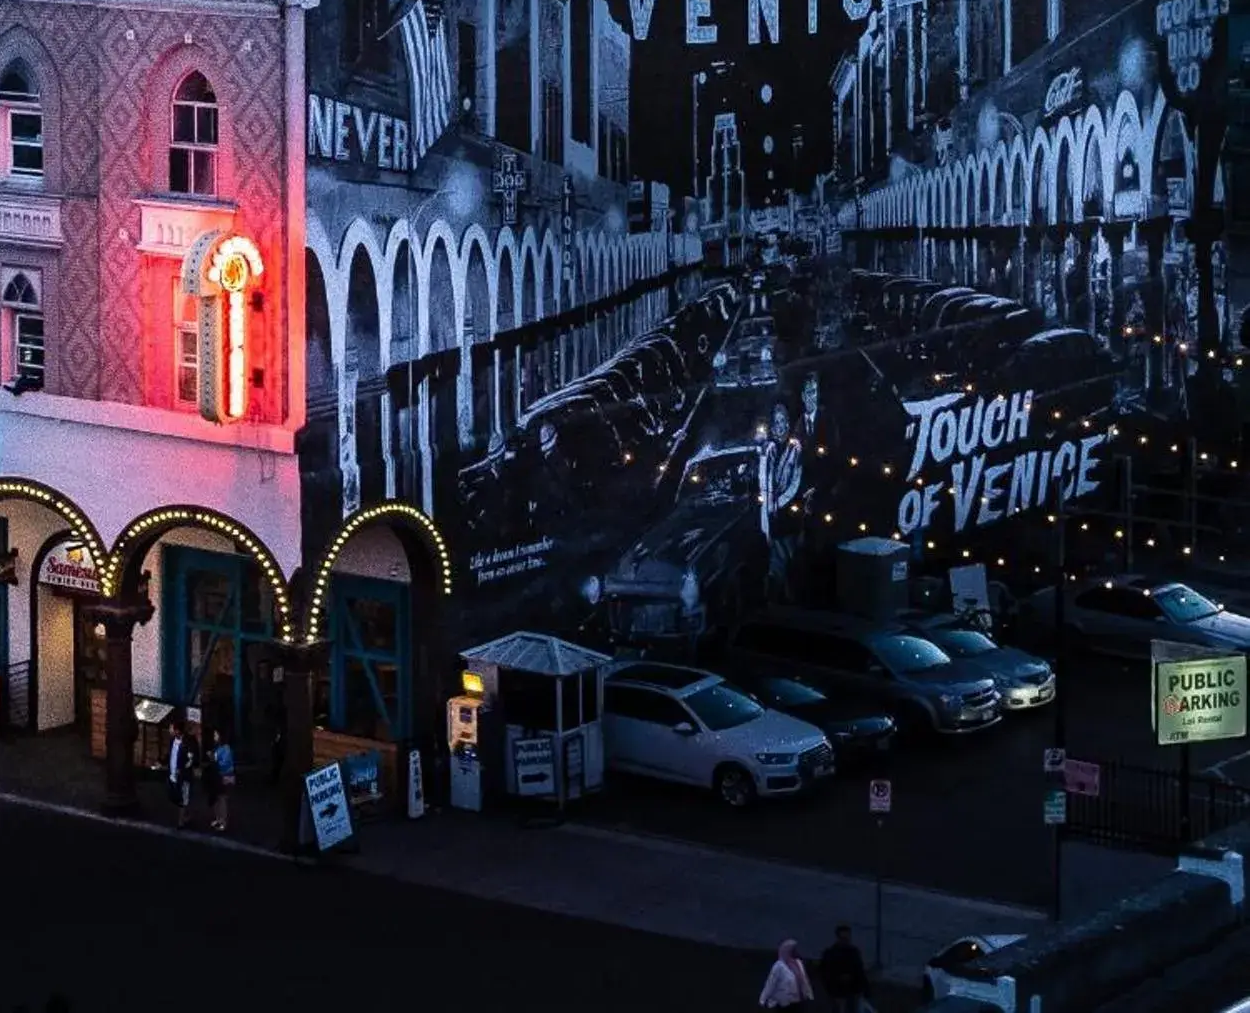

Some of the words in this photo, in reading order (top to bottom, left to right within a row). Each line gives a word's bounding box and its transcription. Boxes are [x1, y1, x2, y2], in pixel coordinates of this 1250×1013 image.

[1168, 26, 1213, 66] DRUG
[308, 93, 410, 172] NEVER
[898, 481, 944, 536] OF
[1169, 670, 1235, 691] PUBLIC
[1165, 691, 1241, 714] ARKING
[308, 768, 338, 788] PUBLIC
